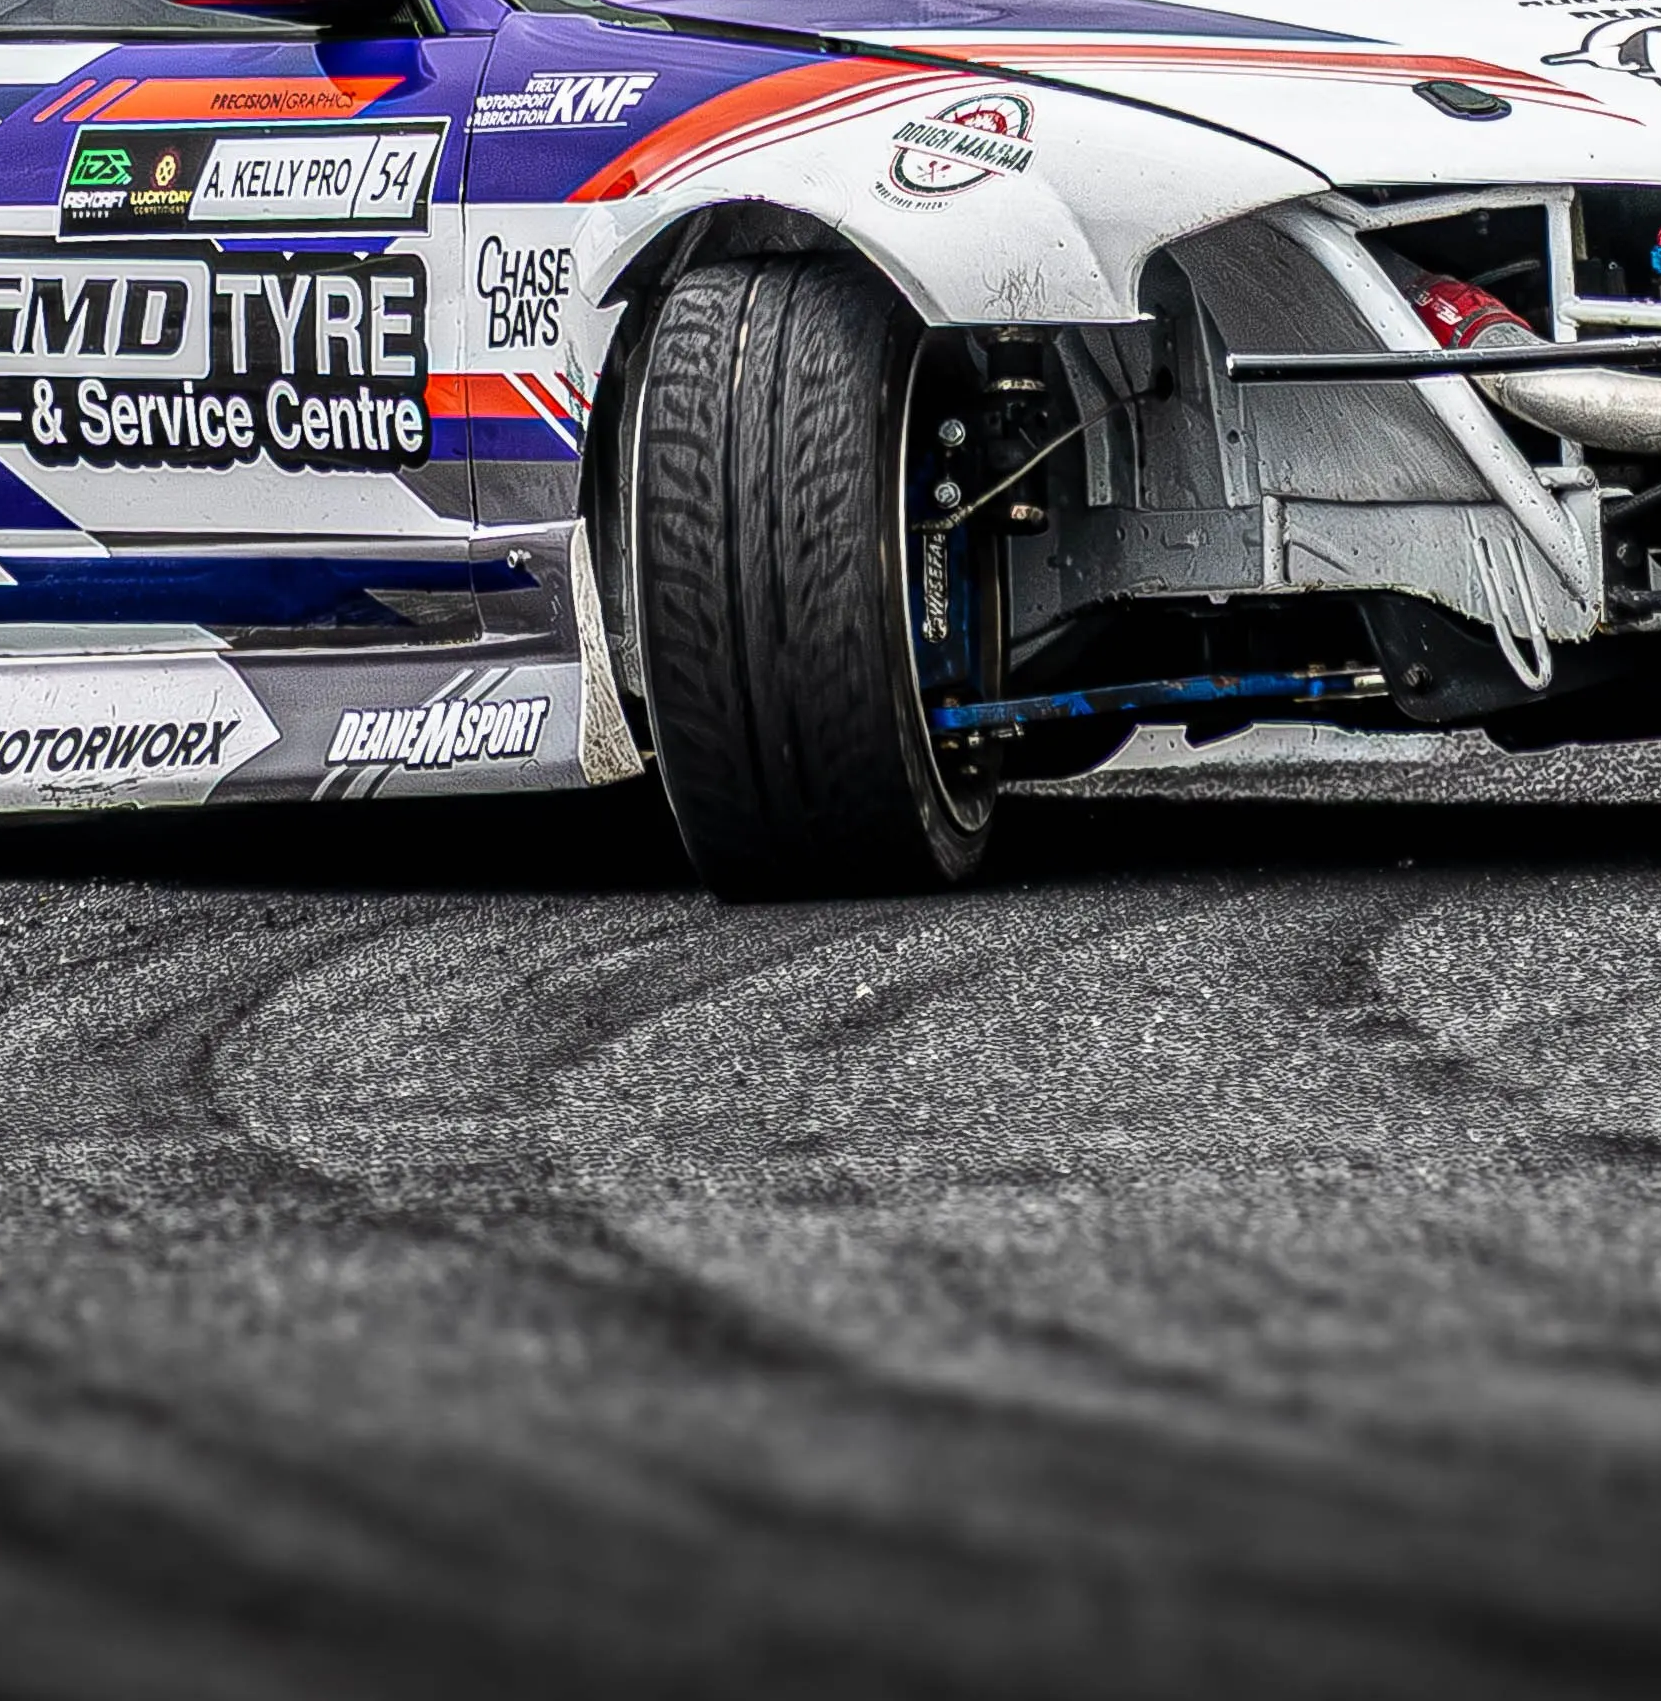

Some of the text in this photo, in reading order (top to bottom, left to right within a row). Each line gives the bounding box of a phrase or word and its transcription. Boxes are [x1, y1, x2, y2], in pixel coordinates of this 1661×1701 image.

[545, 77, 655, 124] KMF
[370, 151, 416, 200] 54
[892, 122, 1033, 173] DOUGH MAMMA
[206, 158, 352, 196] A. KELLY PRO
[478, 236, 572, 297] CHASE
[216, 274, 417, 376] TYRE
[489, 288, 560, 349] BAYS
[31, 379, 423, 452] & Service Centre
